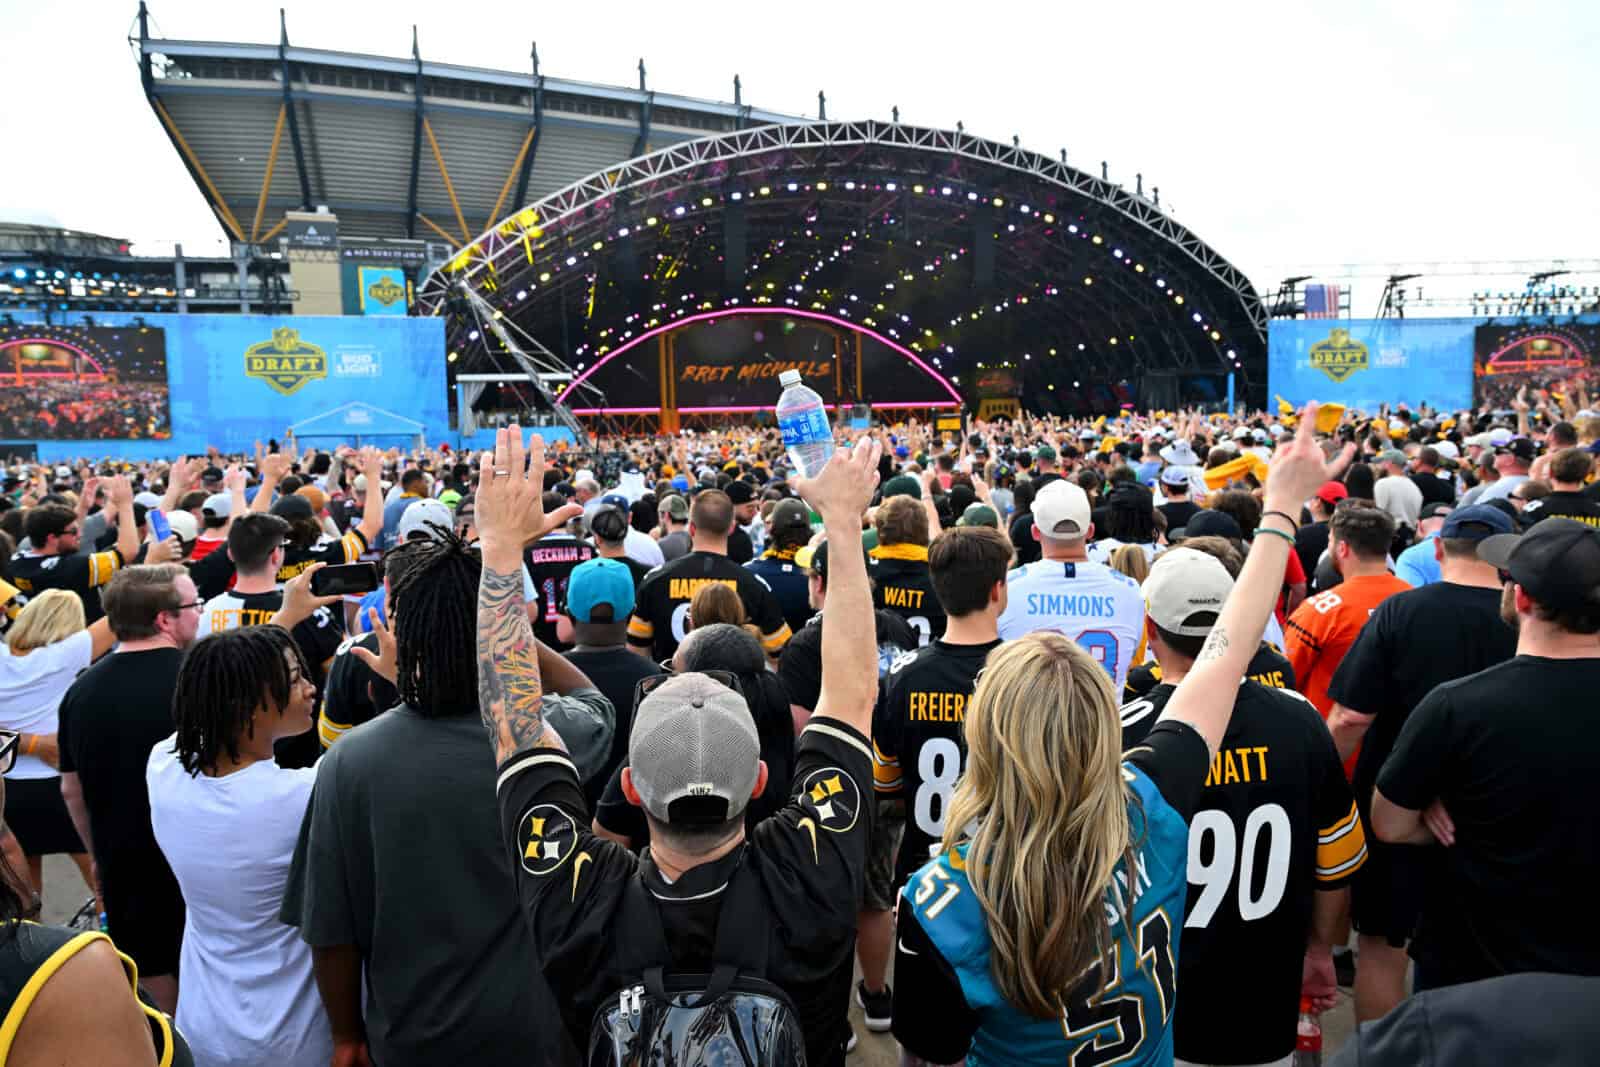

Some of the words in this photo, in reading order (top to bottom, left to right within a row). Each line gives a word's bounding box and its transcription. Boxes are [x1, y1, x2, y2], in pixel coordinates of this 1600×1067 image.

[252, 358, 320, 370] DRAFT
[1314, 352, 1363, 364] DRAFT
[884, 586, 925, 609] WATT
[1027, 593, 1115, 618] SIMMONS
[1184, 803, 1292, 929] 90
[914, 865, 961, 920] 51
[1056, 906, 1176, 1067] 51
